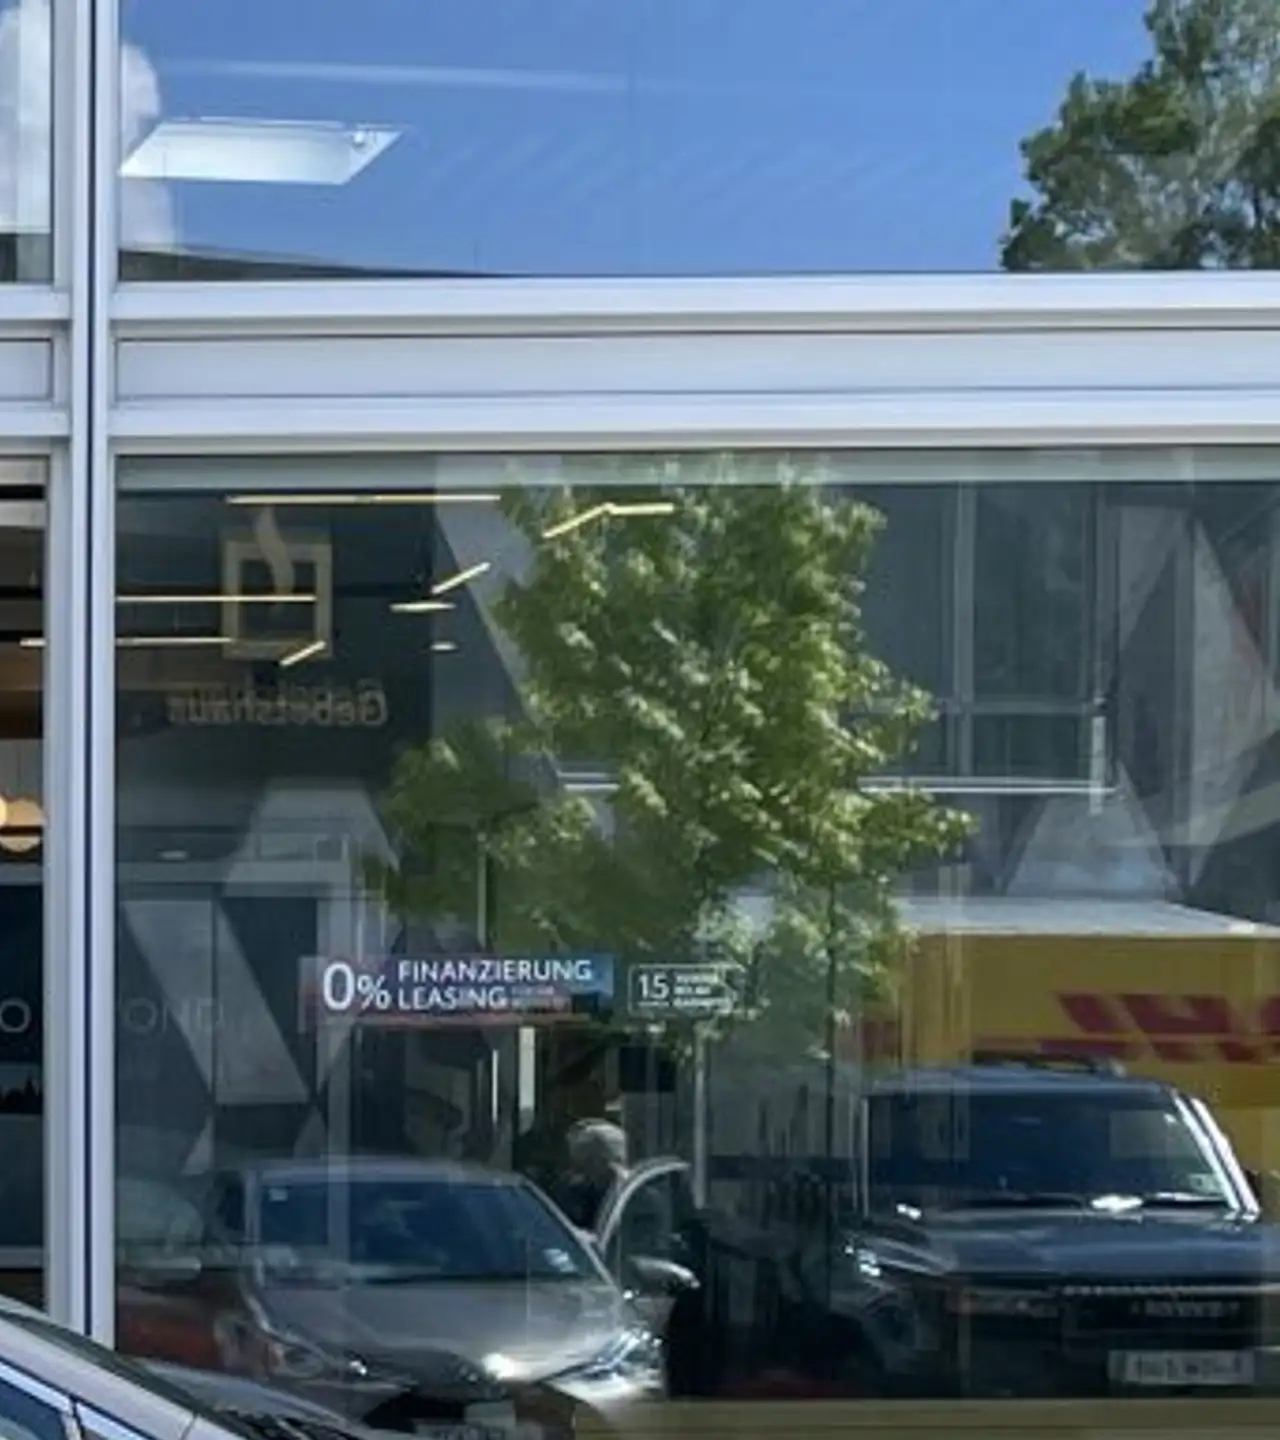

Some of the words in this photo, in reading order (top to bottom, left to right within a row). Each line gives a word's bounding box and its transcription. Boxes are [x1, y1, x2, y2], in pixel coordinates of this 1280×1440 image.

[397, 959, 593, 981] FINANZIERUNG
[323, 962, 390, 1011] 0%
[397, 986, 507, 1011] LEASING
[639, 972, 669, 999] 15
